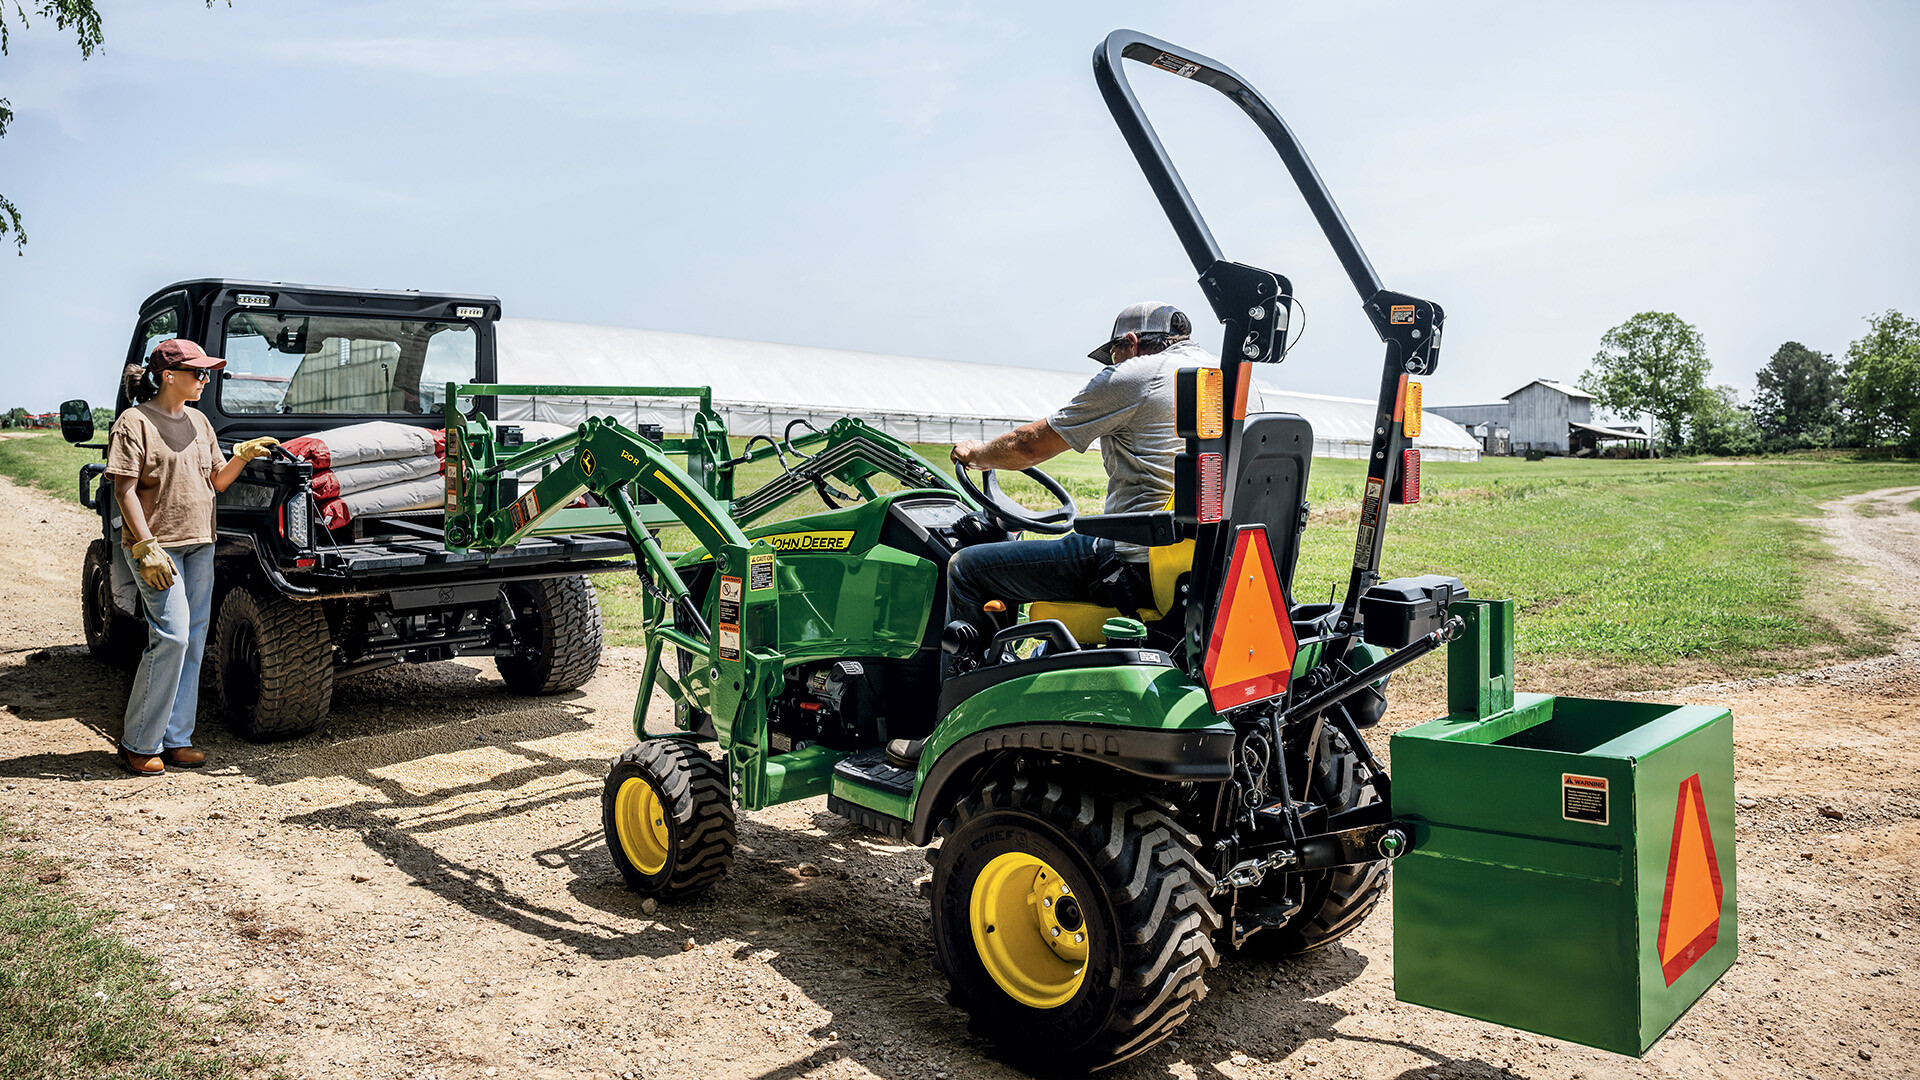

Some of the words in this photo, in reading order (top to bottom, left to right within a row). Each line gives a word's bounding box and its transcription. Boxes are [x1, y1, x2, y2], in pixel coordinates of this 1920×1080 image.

[771, 537, 800, 549] JOHN
[802, 535, 845, 549] DEERE
[1574, 779, 1605, 788] WARNING
